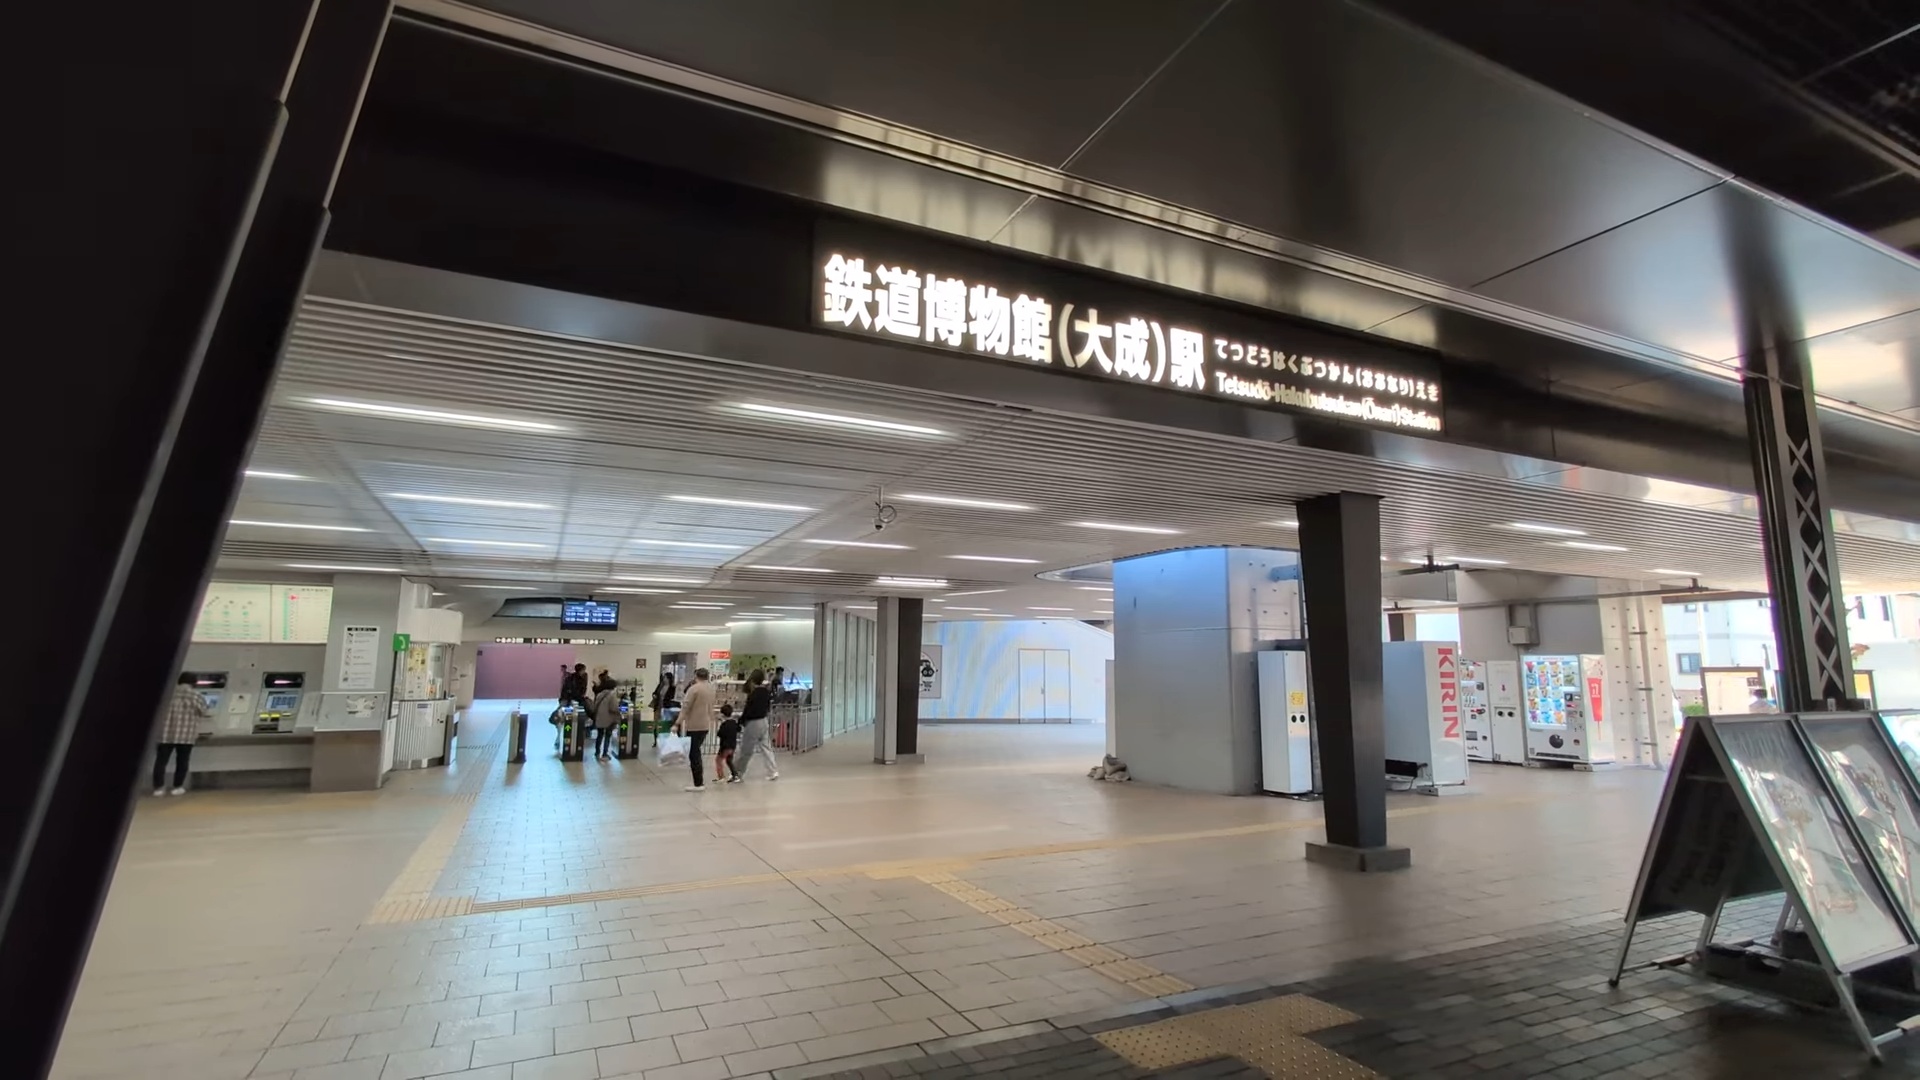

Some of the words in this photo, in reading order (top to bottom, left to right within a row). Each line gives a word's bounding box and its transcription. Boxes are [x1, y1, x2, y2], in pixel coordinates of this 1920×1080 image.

[822, 252, 1207, 390] 鉄道博物館(大成)駅
[1437, 647, 1460, 738] KIRIN
